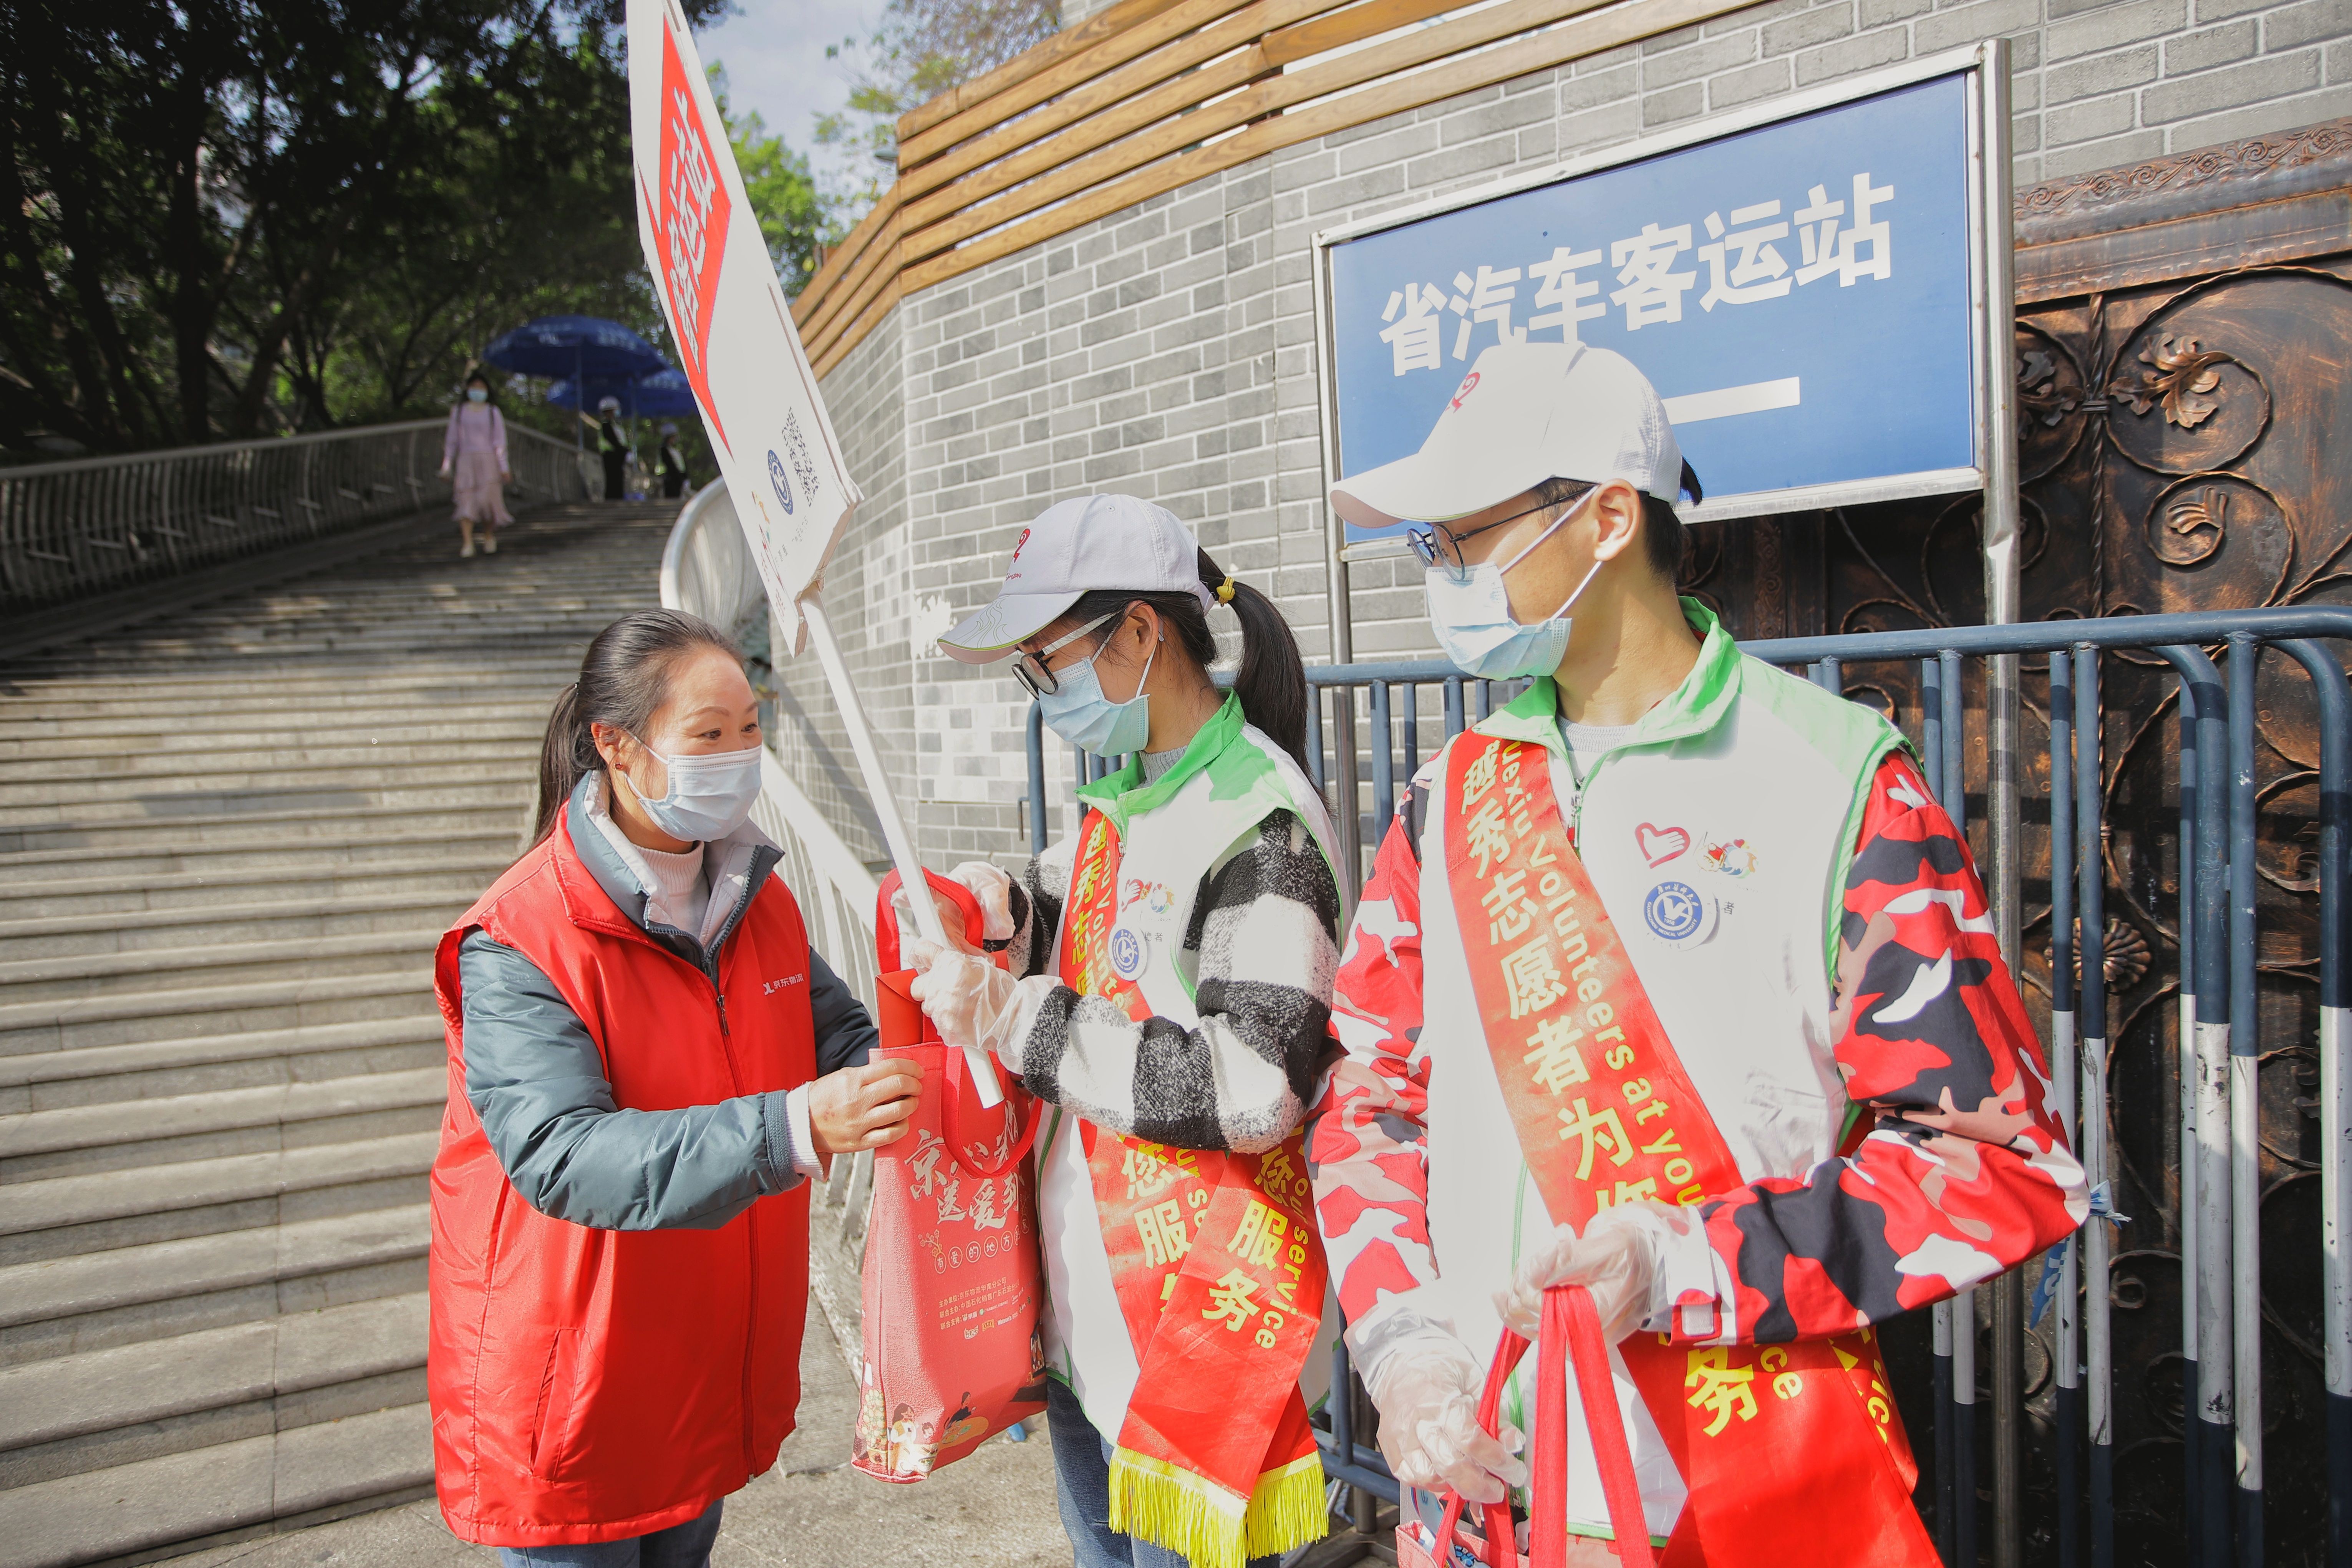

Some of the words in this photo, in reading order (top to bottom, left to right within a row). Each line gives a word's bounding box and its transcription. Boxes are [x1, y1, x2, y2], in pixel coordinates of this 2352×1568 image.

[667, 86, 716, 375] 省客运站
[1379, 172, 1894, 376] 省汽车客运站
[1502, 741, 1533, 840] uexiu
[773, 973, 804, 989] 京东物流
[1093, 887, 1130, 1021] Volunte
[1529, 834, 1635, 1071] Volunteers
[1621, 1077, 1669, 1126] at
[1640, 1128, 1706, 1207] you
[1255, 1225, 1308, 1349] service
